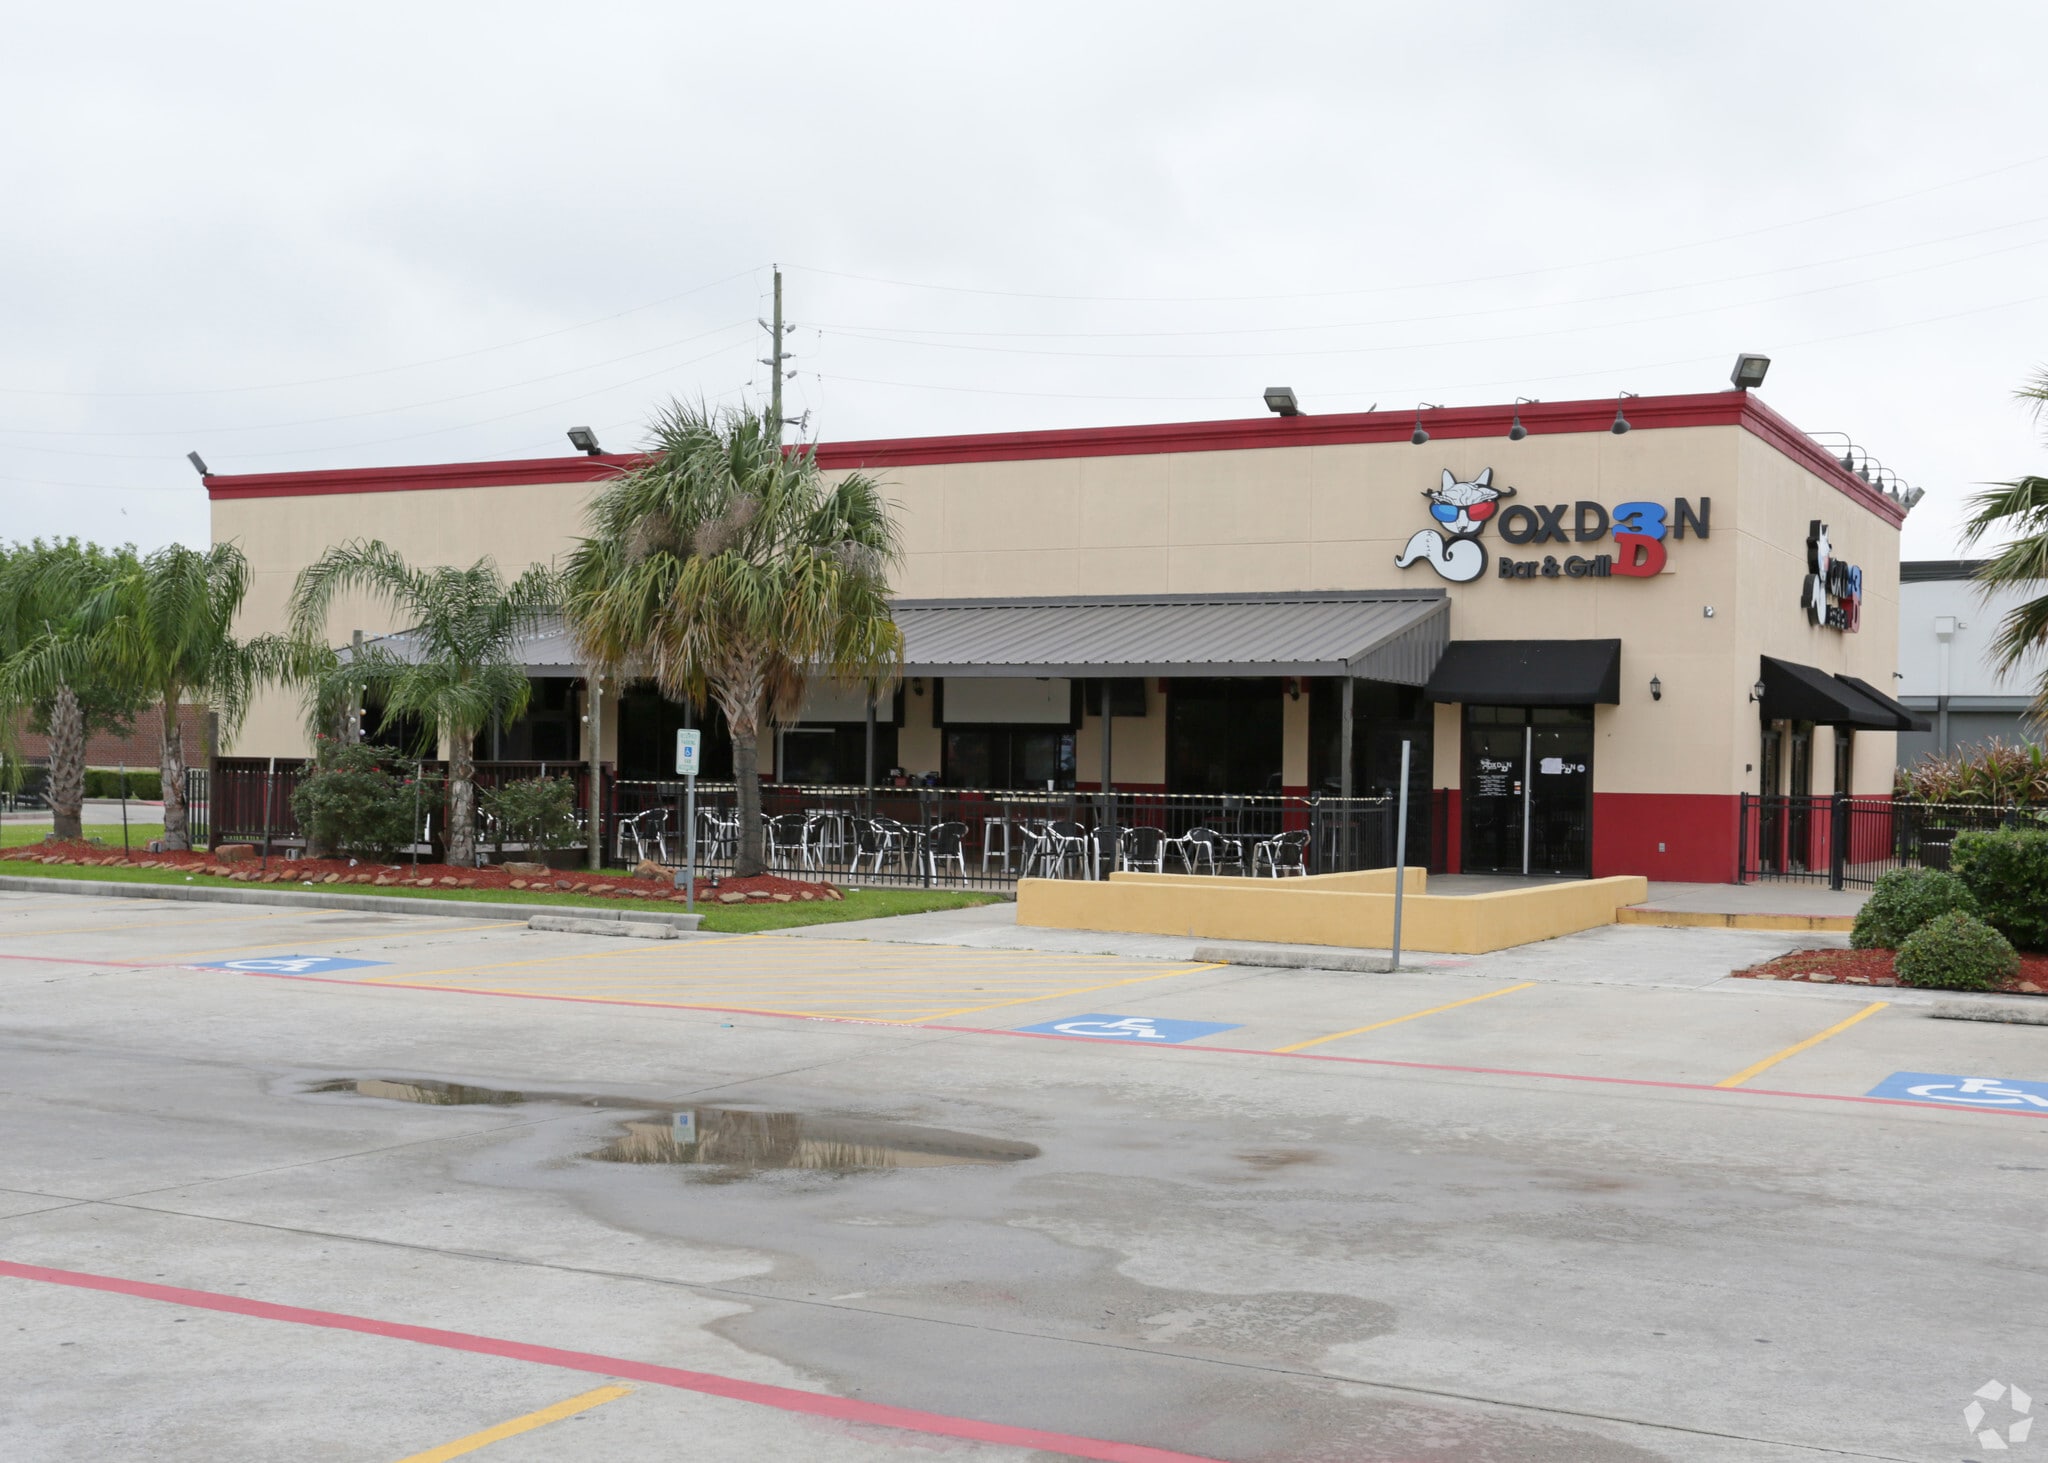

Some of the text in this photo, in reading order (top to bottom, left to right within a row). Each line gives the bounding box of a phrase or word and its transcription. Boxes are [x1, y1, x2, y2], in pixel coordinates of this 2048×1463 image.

[1498, 554, 1612, 579] Bar & Grill
